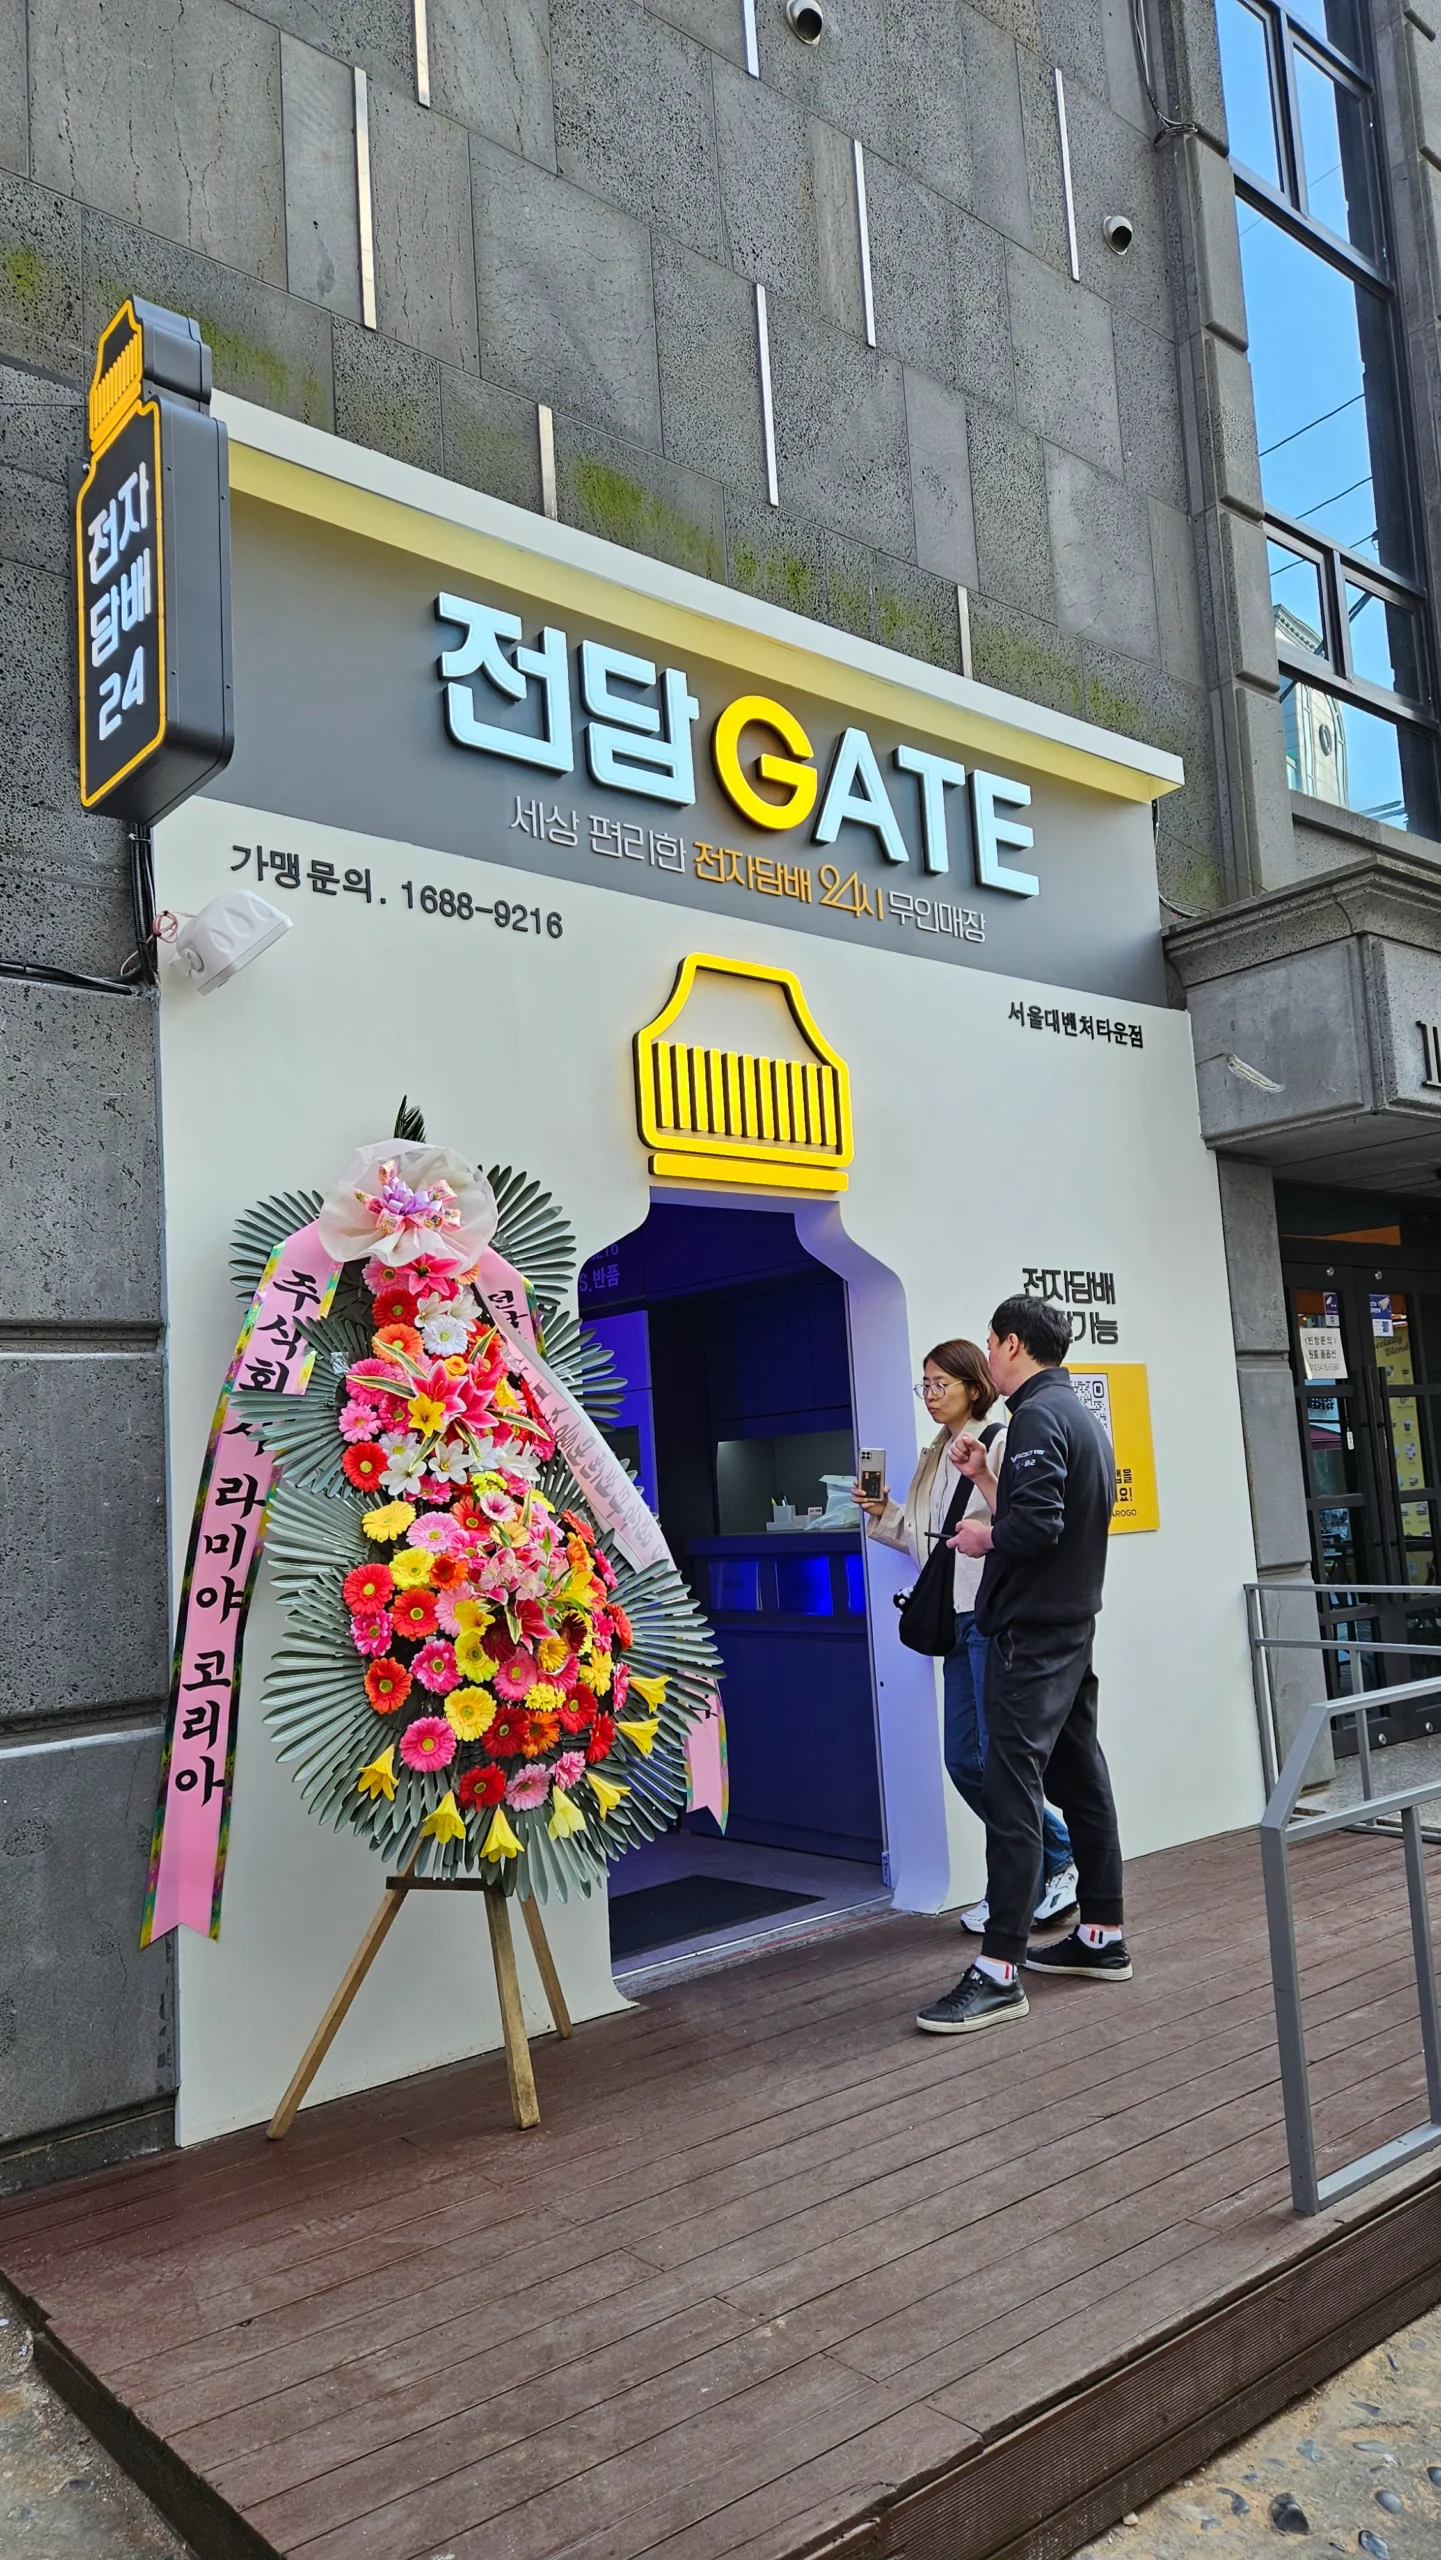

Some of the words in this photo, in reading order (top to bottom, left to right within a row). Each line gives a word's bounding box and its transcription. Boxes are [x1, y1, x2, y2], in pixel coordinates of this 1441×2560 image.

[88, 461, 149, 585] 전자
[90, 547, 151, 668] 담배
[99, 645, 144, 741] 24
[401, 880, 564, 939] 1688-9216
[510, 795, 579, 847] 세상
[588, 813, 687, 873] 편리한
[692, 841, 813, 903] 전자담배
[887, 890, 987, 943] 무인매장
[1008, 1001, 1144, 1049] 서울대벤처타운점
[1022, 1267, 1116, 1304] 전자담배
[174, 1649, 232, 1808] 코리아
